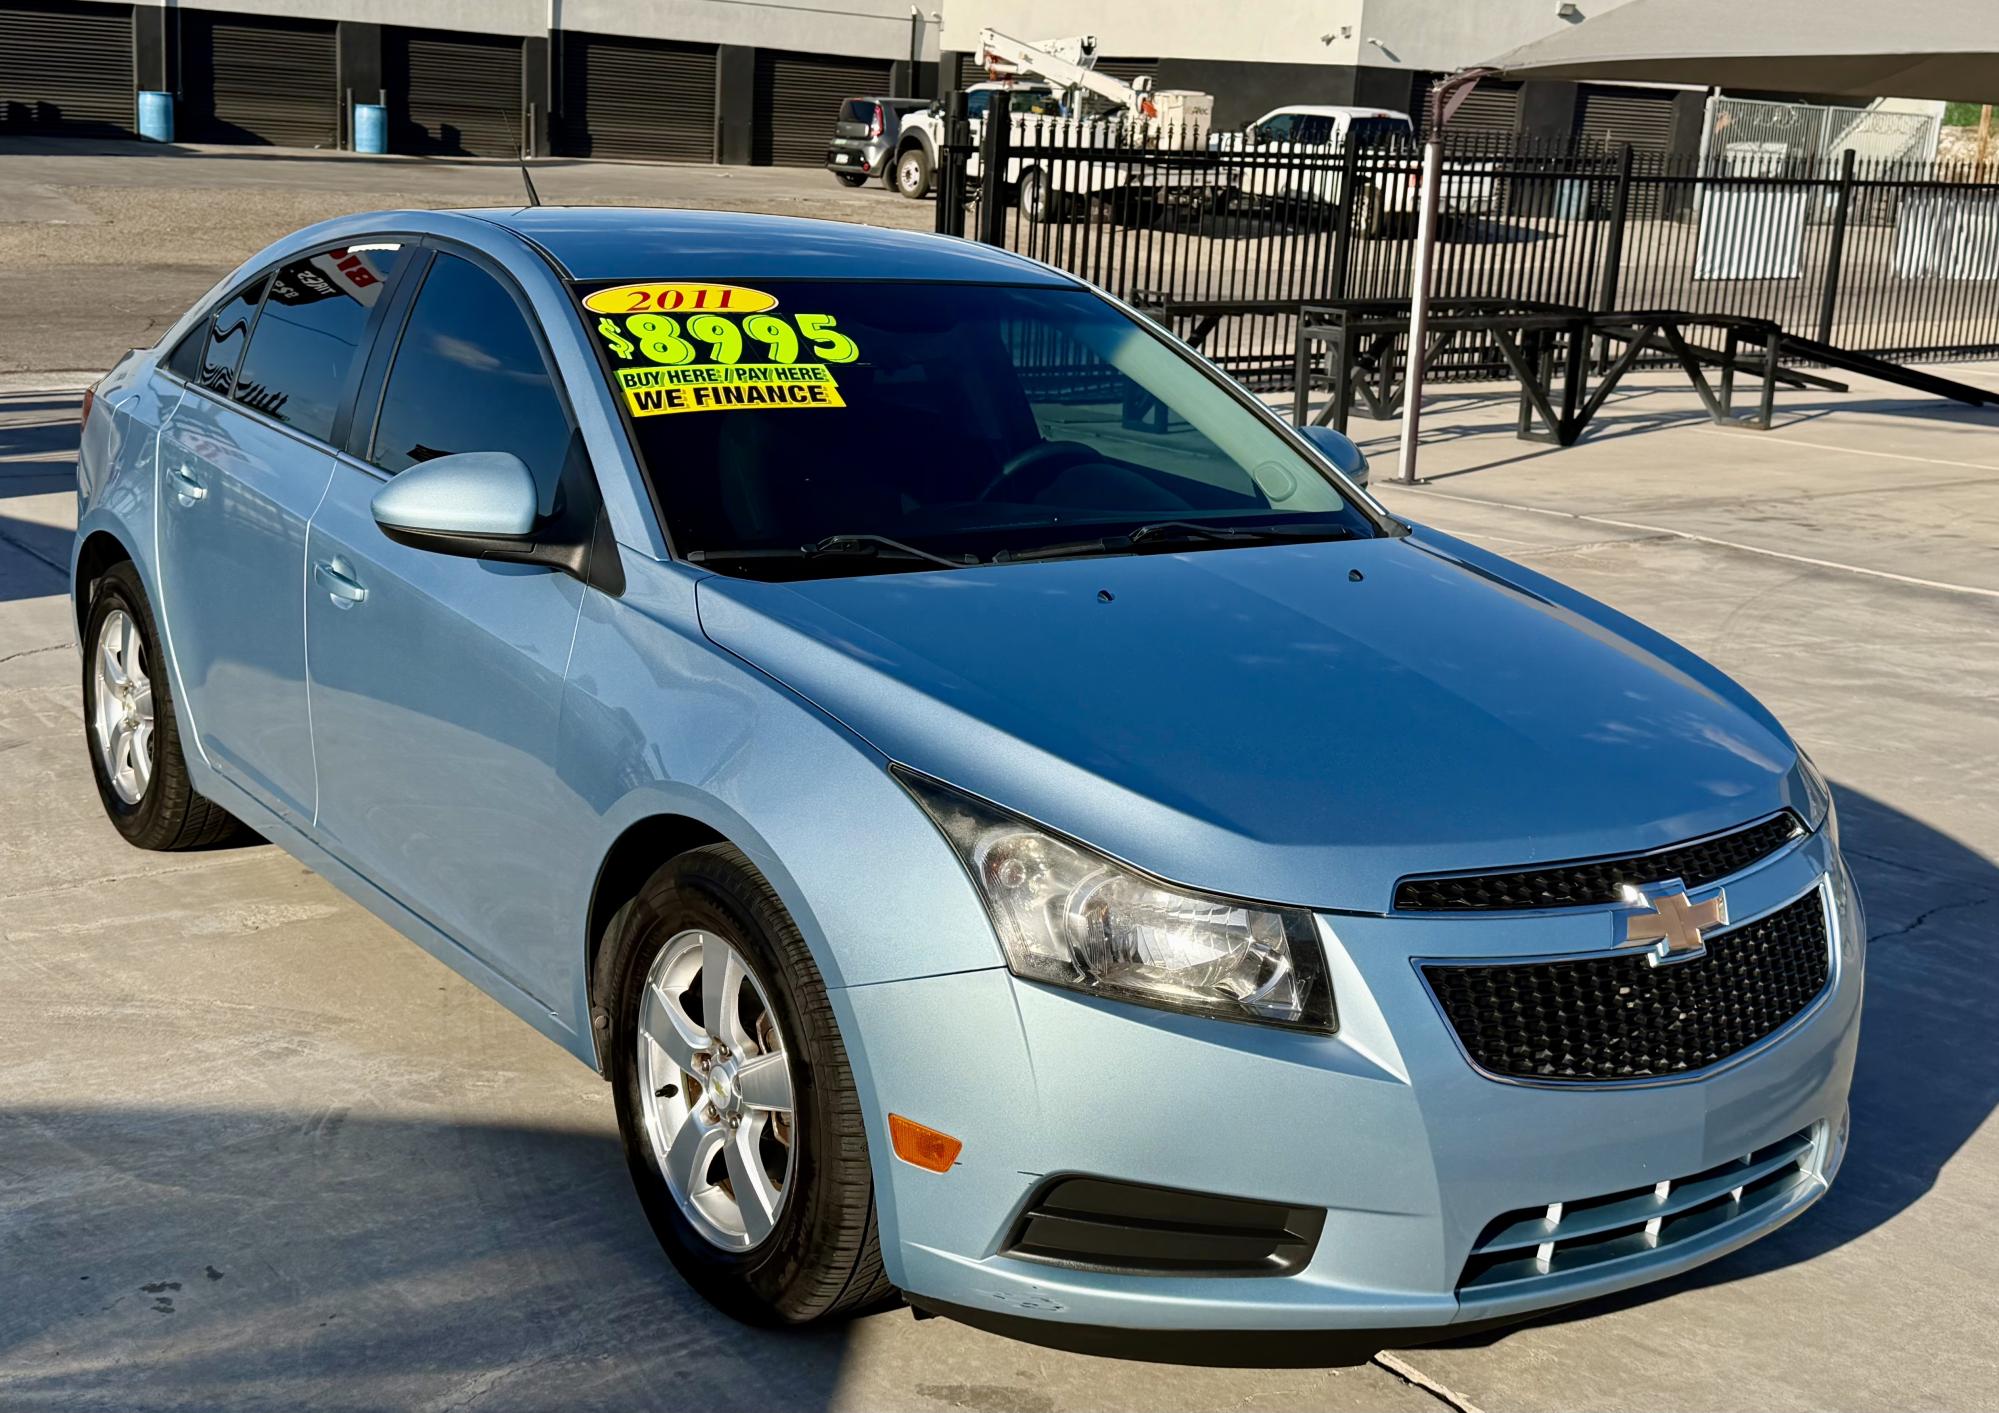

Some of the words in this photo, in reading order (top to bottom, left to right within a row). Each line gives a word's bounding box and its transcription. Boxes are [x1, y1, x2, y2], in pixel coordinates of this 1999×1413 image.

[626, 289, 733, 312] 2011
[598, 313, 860, 365] $8995
[623, 371, 661, 388] BUY
[667, 368, 719, 384] HERE
[735, 367, 769, 382] PAY
[775, 367, 825, 381] HERE
[633, 388, 686, 411] WE
[693, 385, 828, 406] FINANCE
